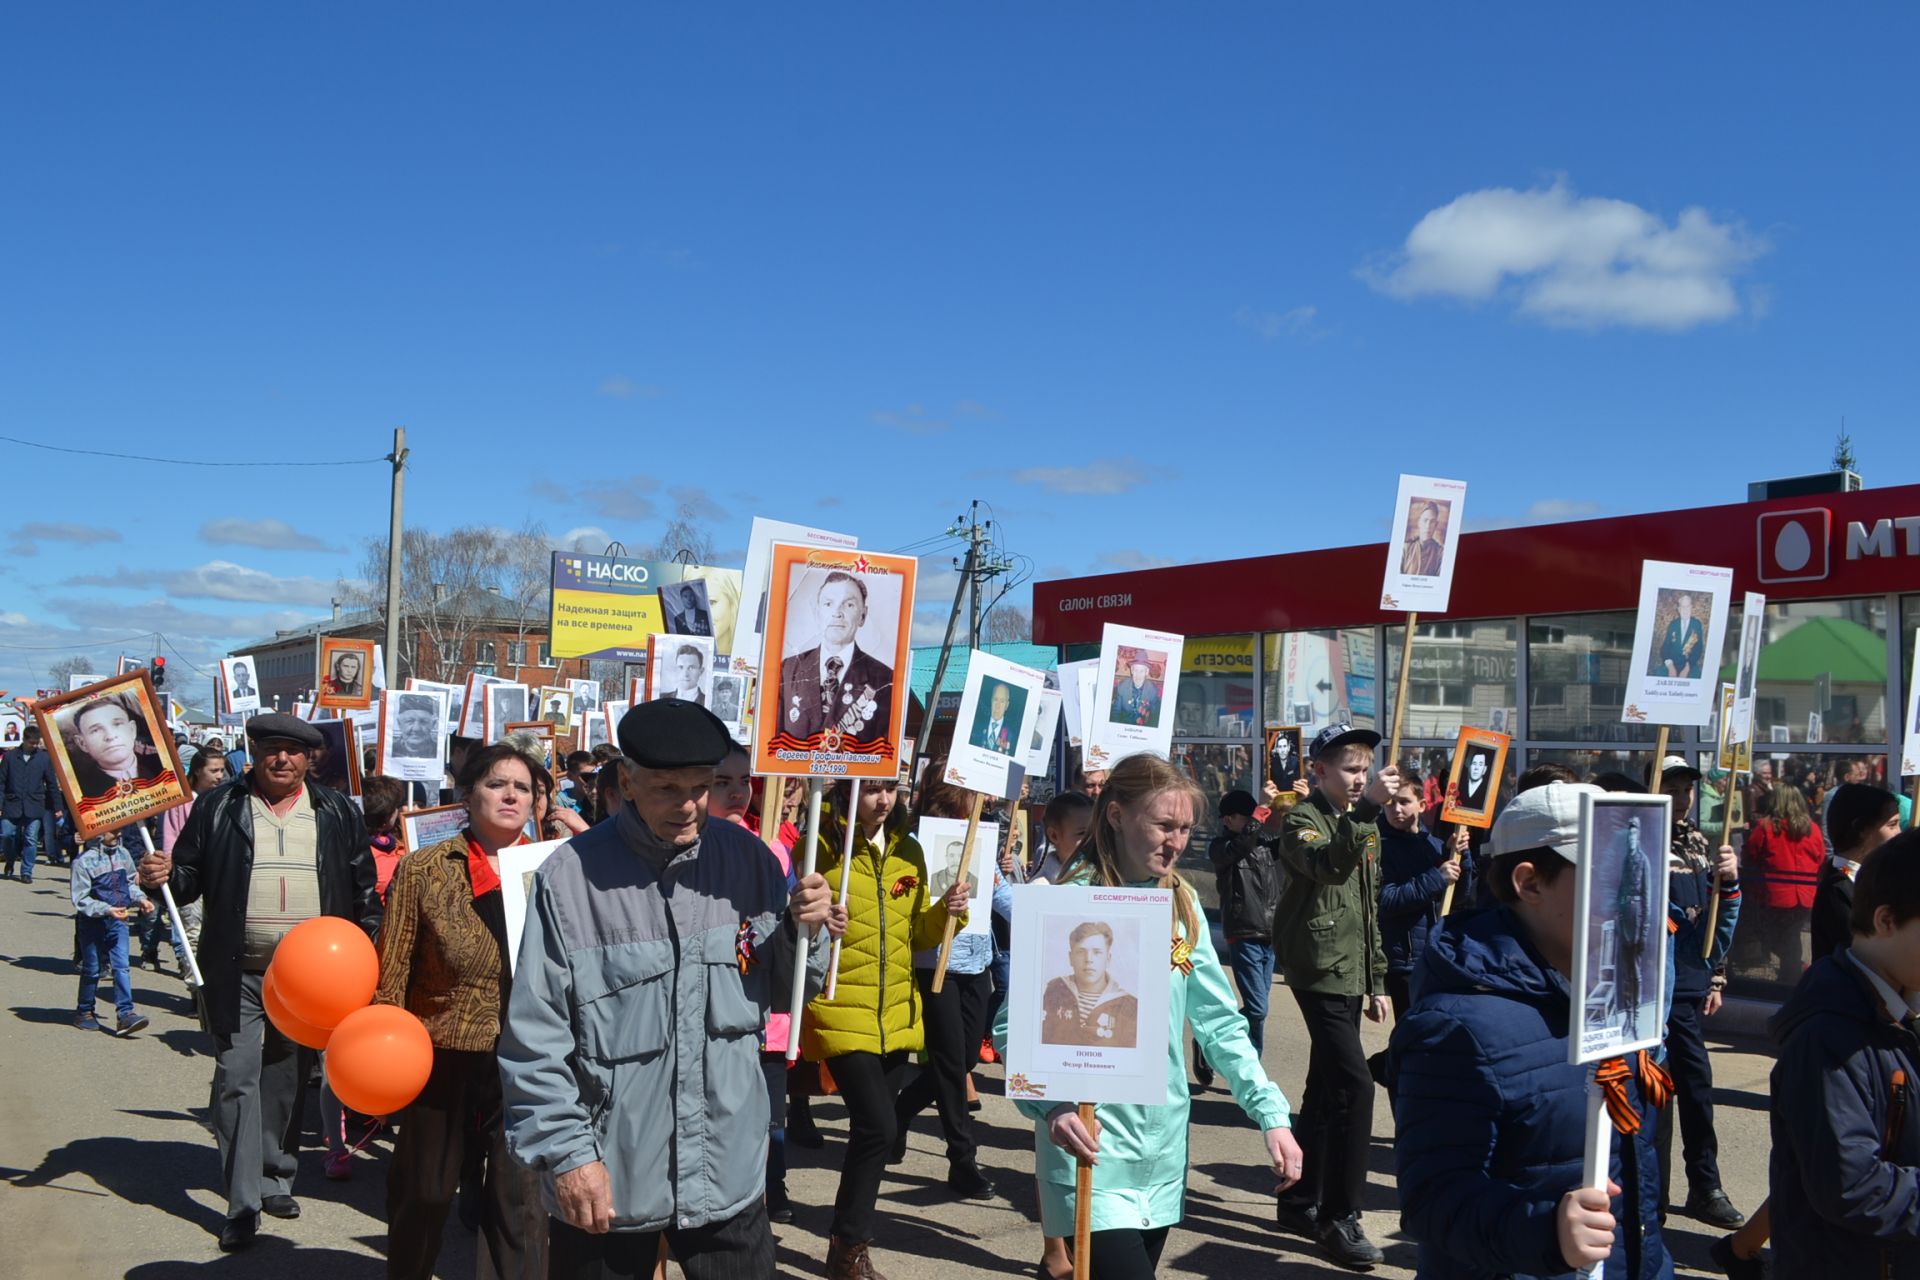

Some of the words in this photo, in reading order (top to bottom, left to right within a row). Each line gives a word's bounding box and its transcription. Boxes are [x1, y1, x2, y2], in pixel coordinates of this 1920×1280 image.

[587, 561, 648, 582] НАСКО
[1059, 597, 1094, 611] салон
[1097, 593, 1132, 608] связи
[558, 603, 609, 616] Надежная
[611, 608, 647, 619] защита
[557, 619, 569, 627] на
[571, 620, 588, 628] все
[590, 622, 633, 632] времена
[777, 749, 809, 761] Сергеев
[811, 751, 841, 762] Трофим
[843, 752, 881, 763] Павлович
[810, 764, 847, 773] 1917-1990
[95, 787, 168, 818] МИХАЙЛОВСКИЙ
[87, 812, 127, 830] Григорий
[129, 794, 181, 816] Трофимович
[1094, 894, 1148, 902] БЕССМЕРТНЫЙ
